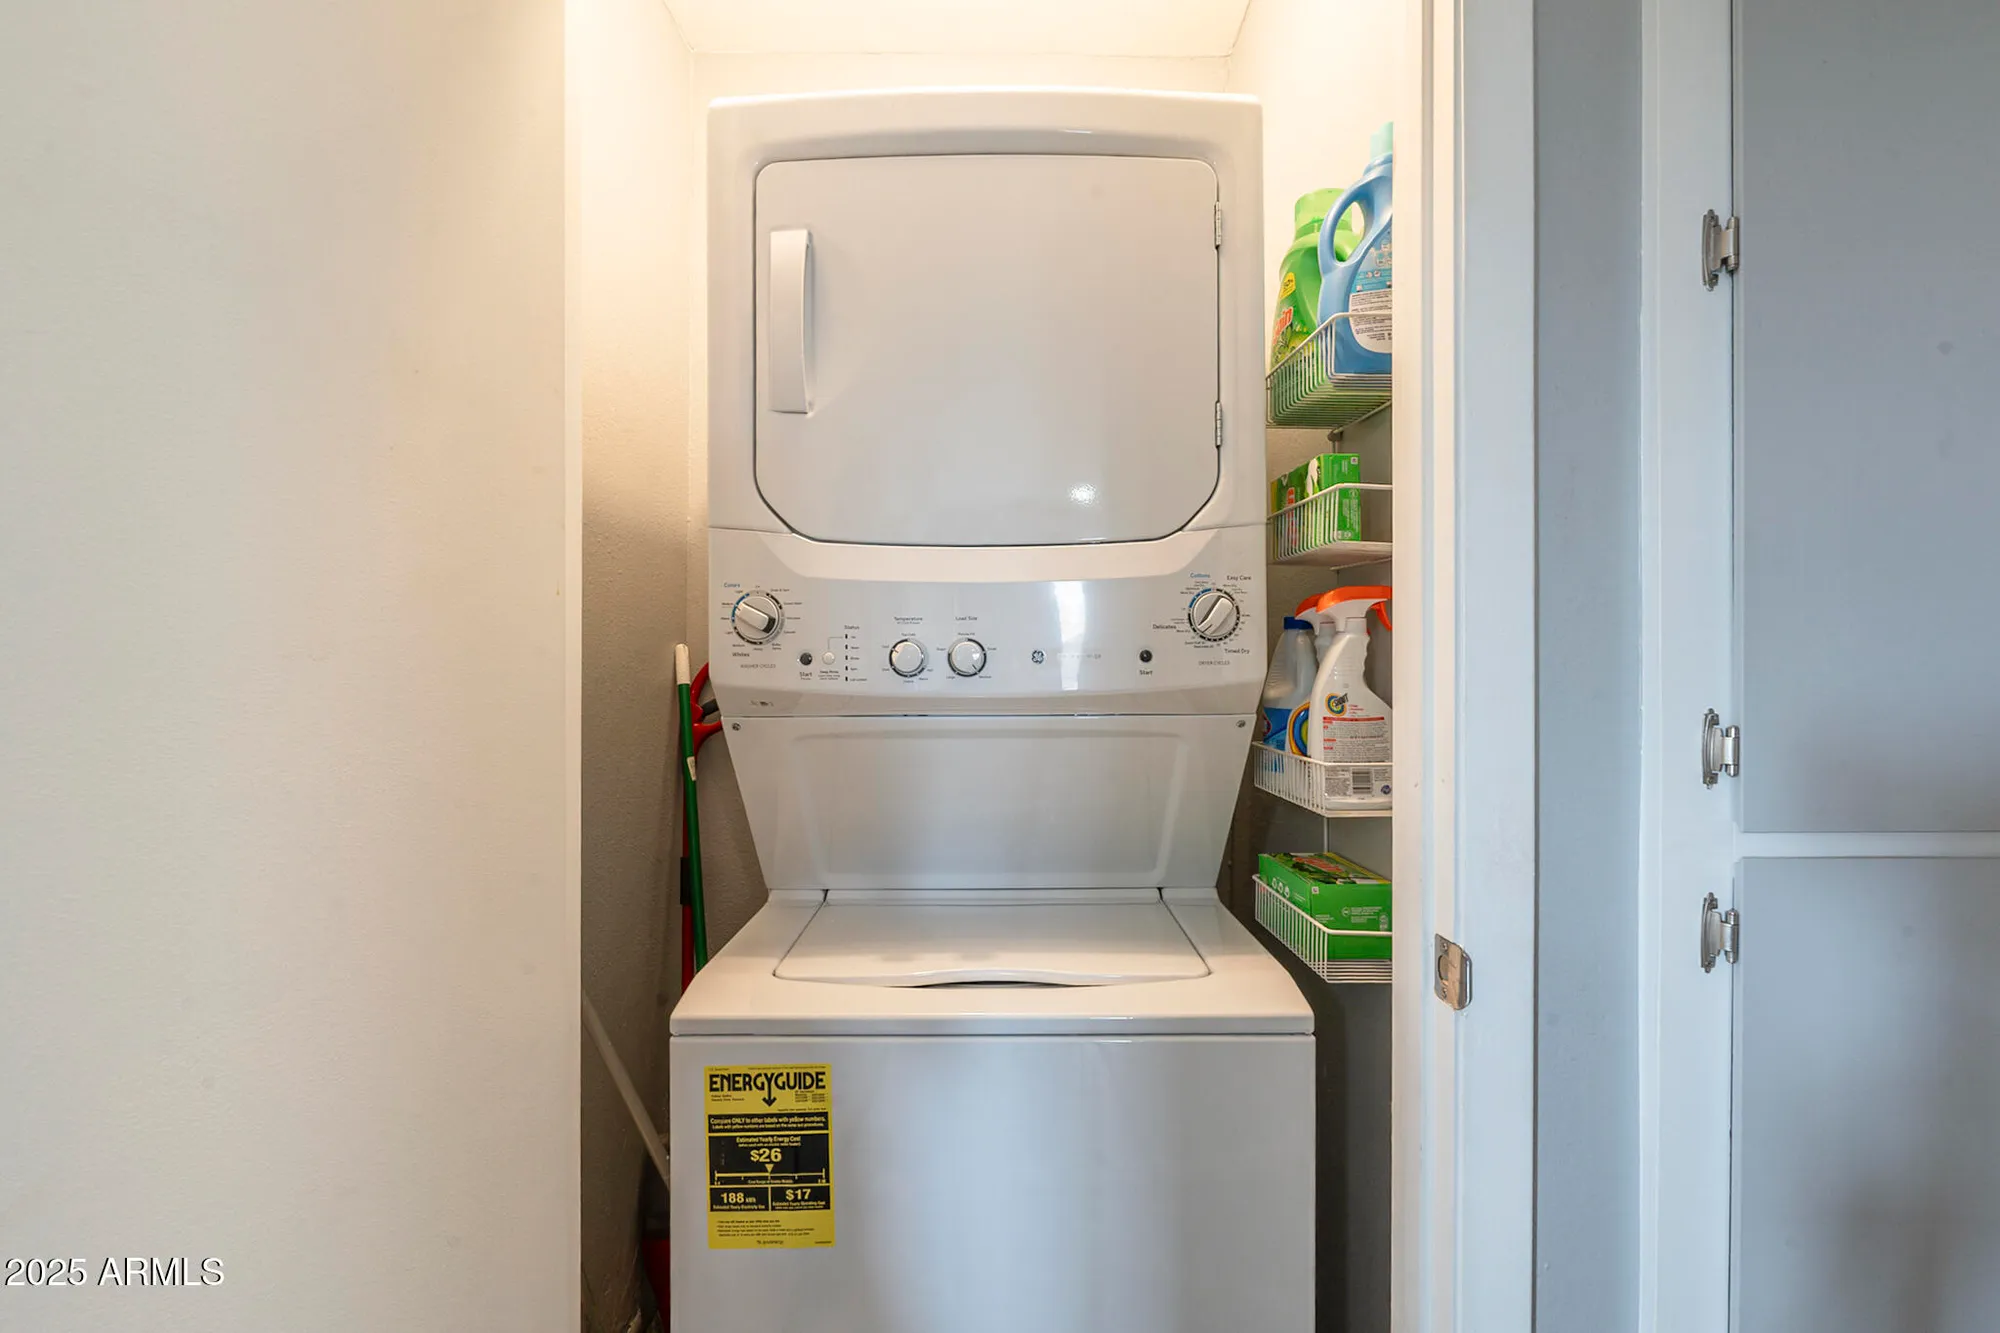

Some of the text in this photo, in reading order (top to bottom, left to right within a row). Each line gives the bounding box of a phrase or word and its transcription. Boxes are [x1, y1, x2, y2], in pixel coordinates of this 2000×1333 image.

[709, 1071, 826, 1092] ENERGYGUIDE
[750, 1148, 782, 1162] $26
[721, 1192, 744, 1204] 188
[785, 1189, 811, 1200] $17
